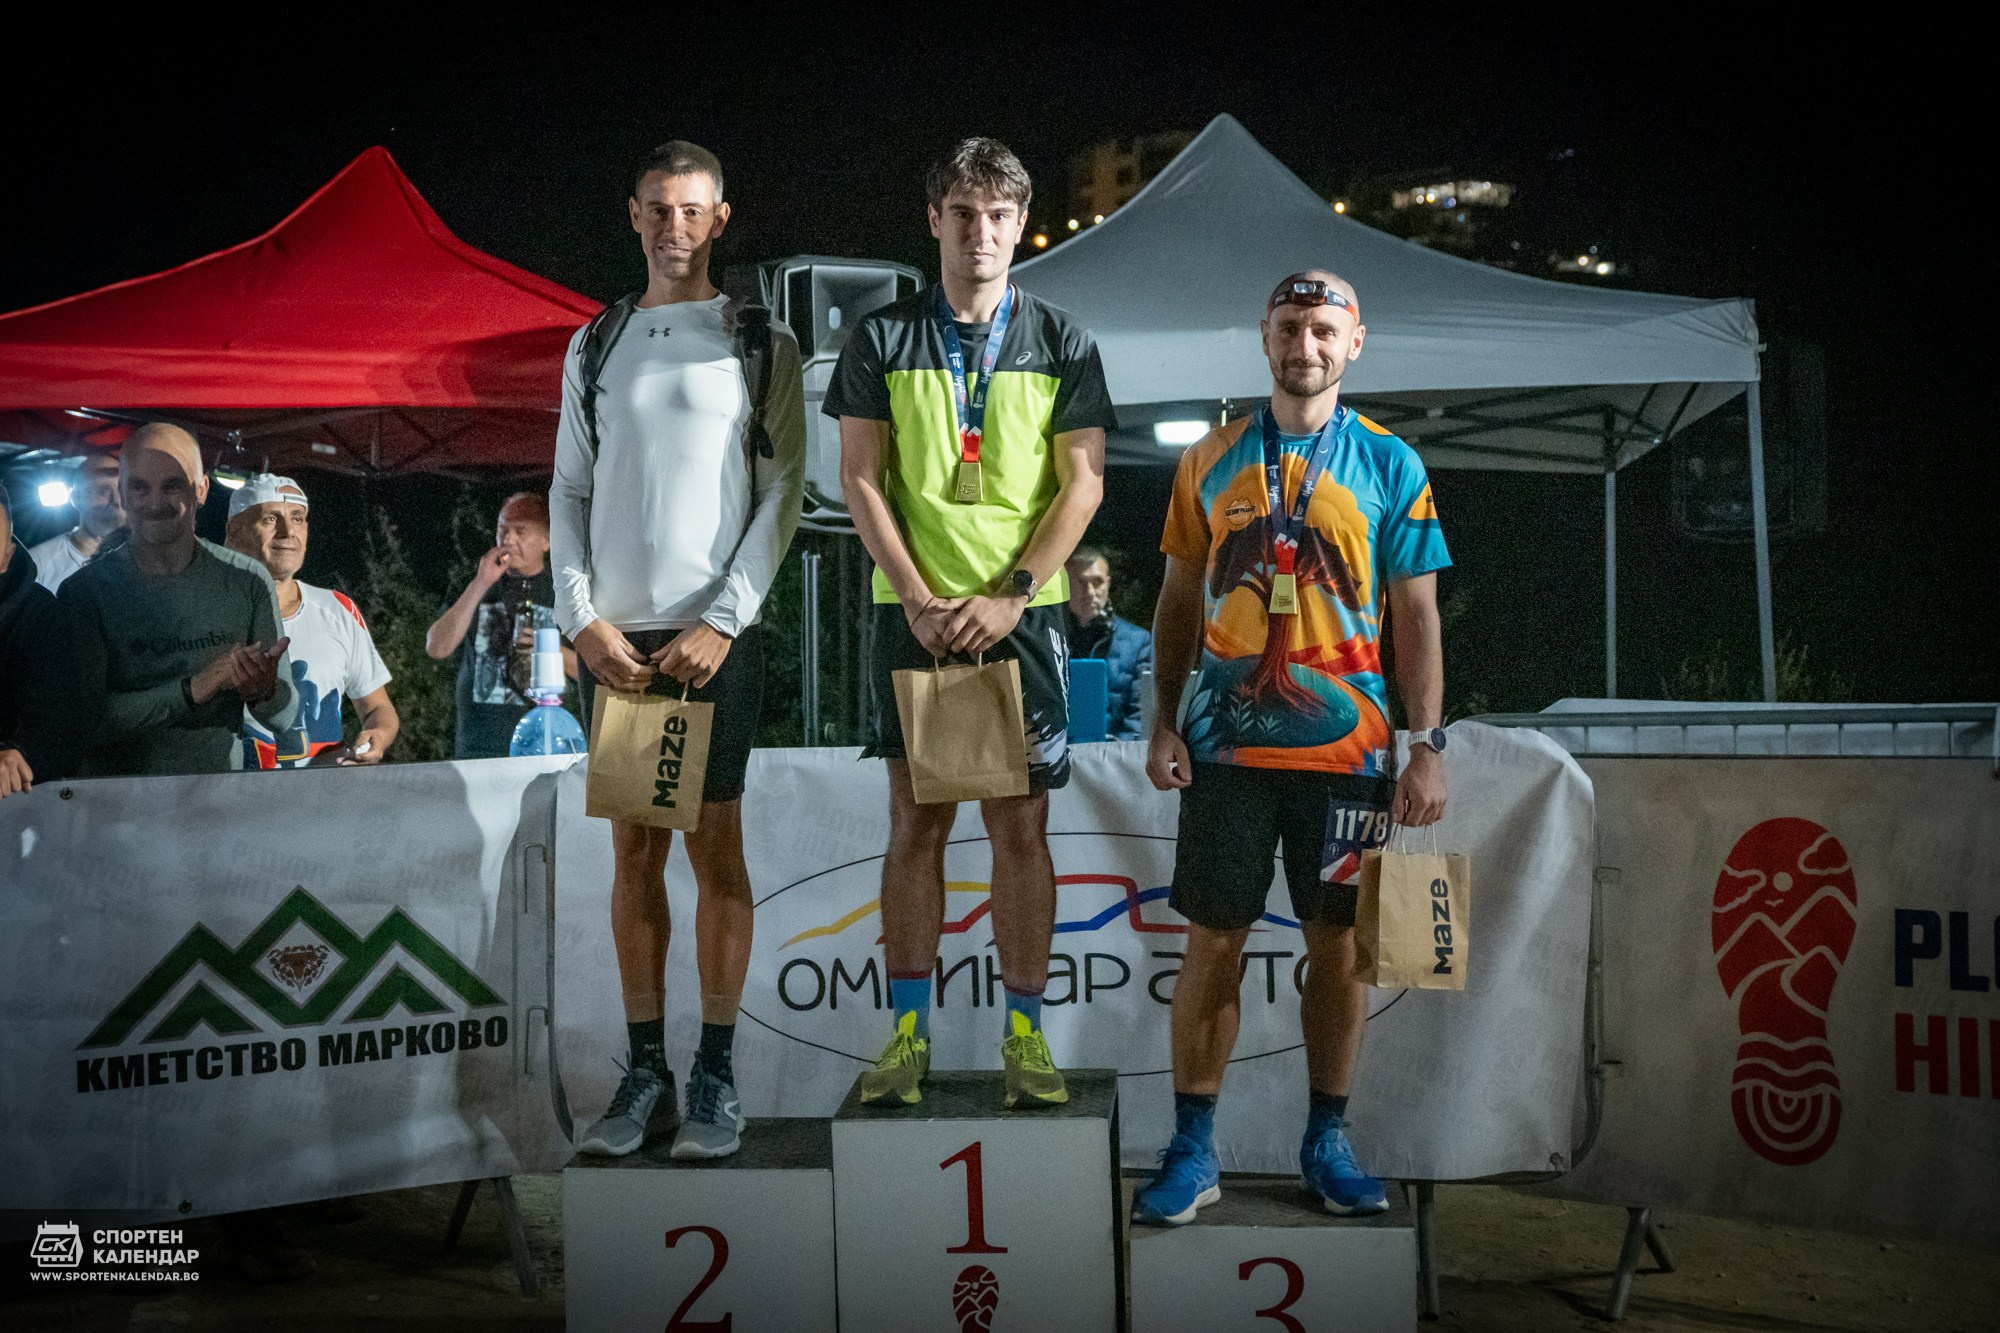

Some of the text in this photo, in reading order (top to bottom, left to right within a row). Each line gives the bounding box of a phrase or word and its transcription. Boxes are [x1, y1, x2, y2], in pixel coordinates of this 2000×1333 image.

[651, 715, 688, 809] Maze
[1335, 808, 1389, 843] 1178
[1430, 877, 1454, 975] Maze
[1895, 908, 2000, 992] PL
[76, 1016, 508, 1093] КМЕТСТВО МАРКОВО
[1895, 1013, 2000, 1099] HI
[939, 1141, 1008, 1254] 1
[664, 1225, 732, 1333] 2
[1238, 1256, 1306, 1333] 3
